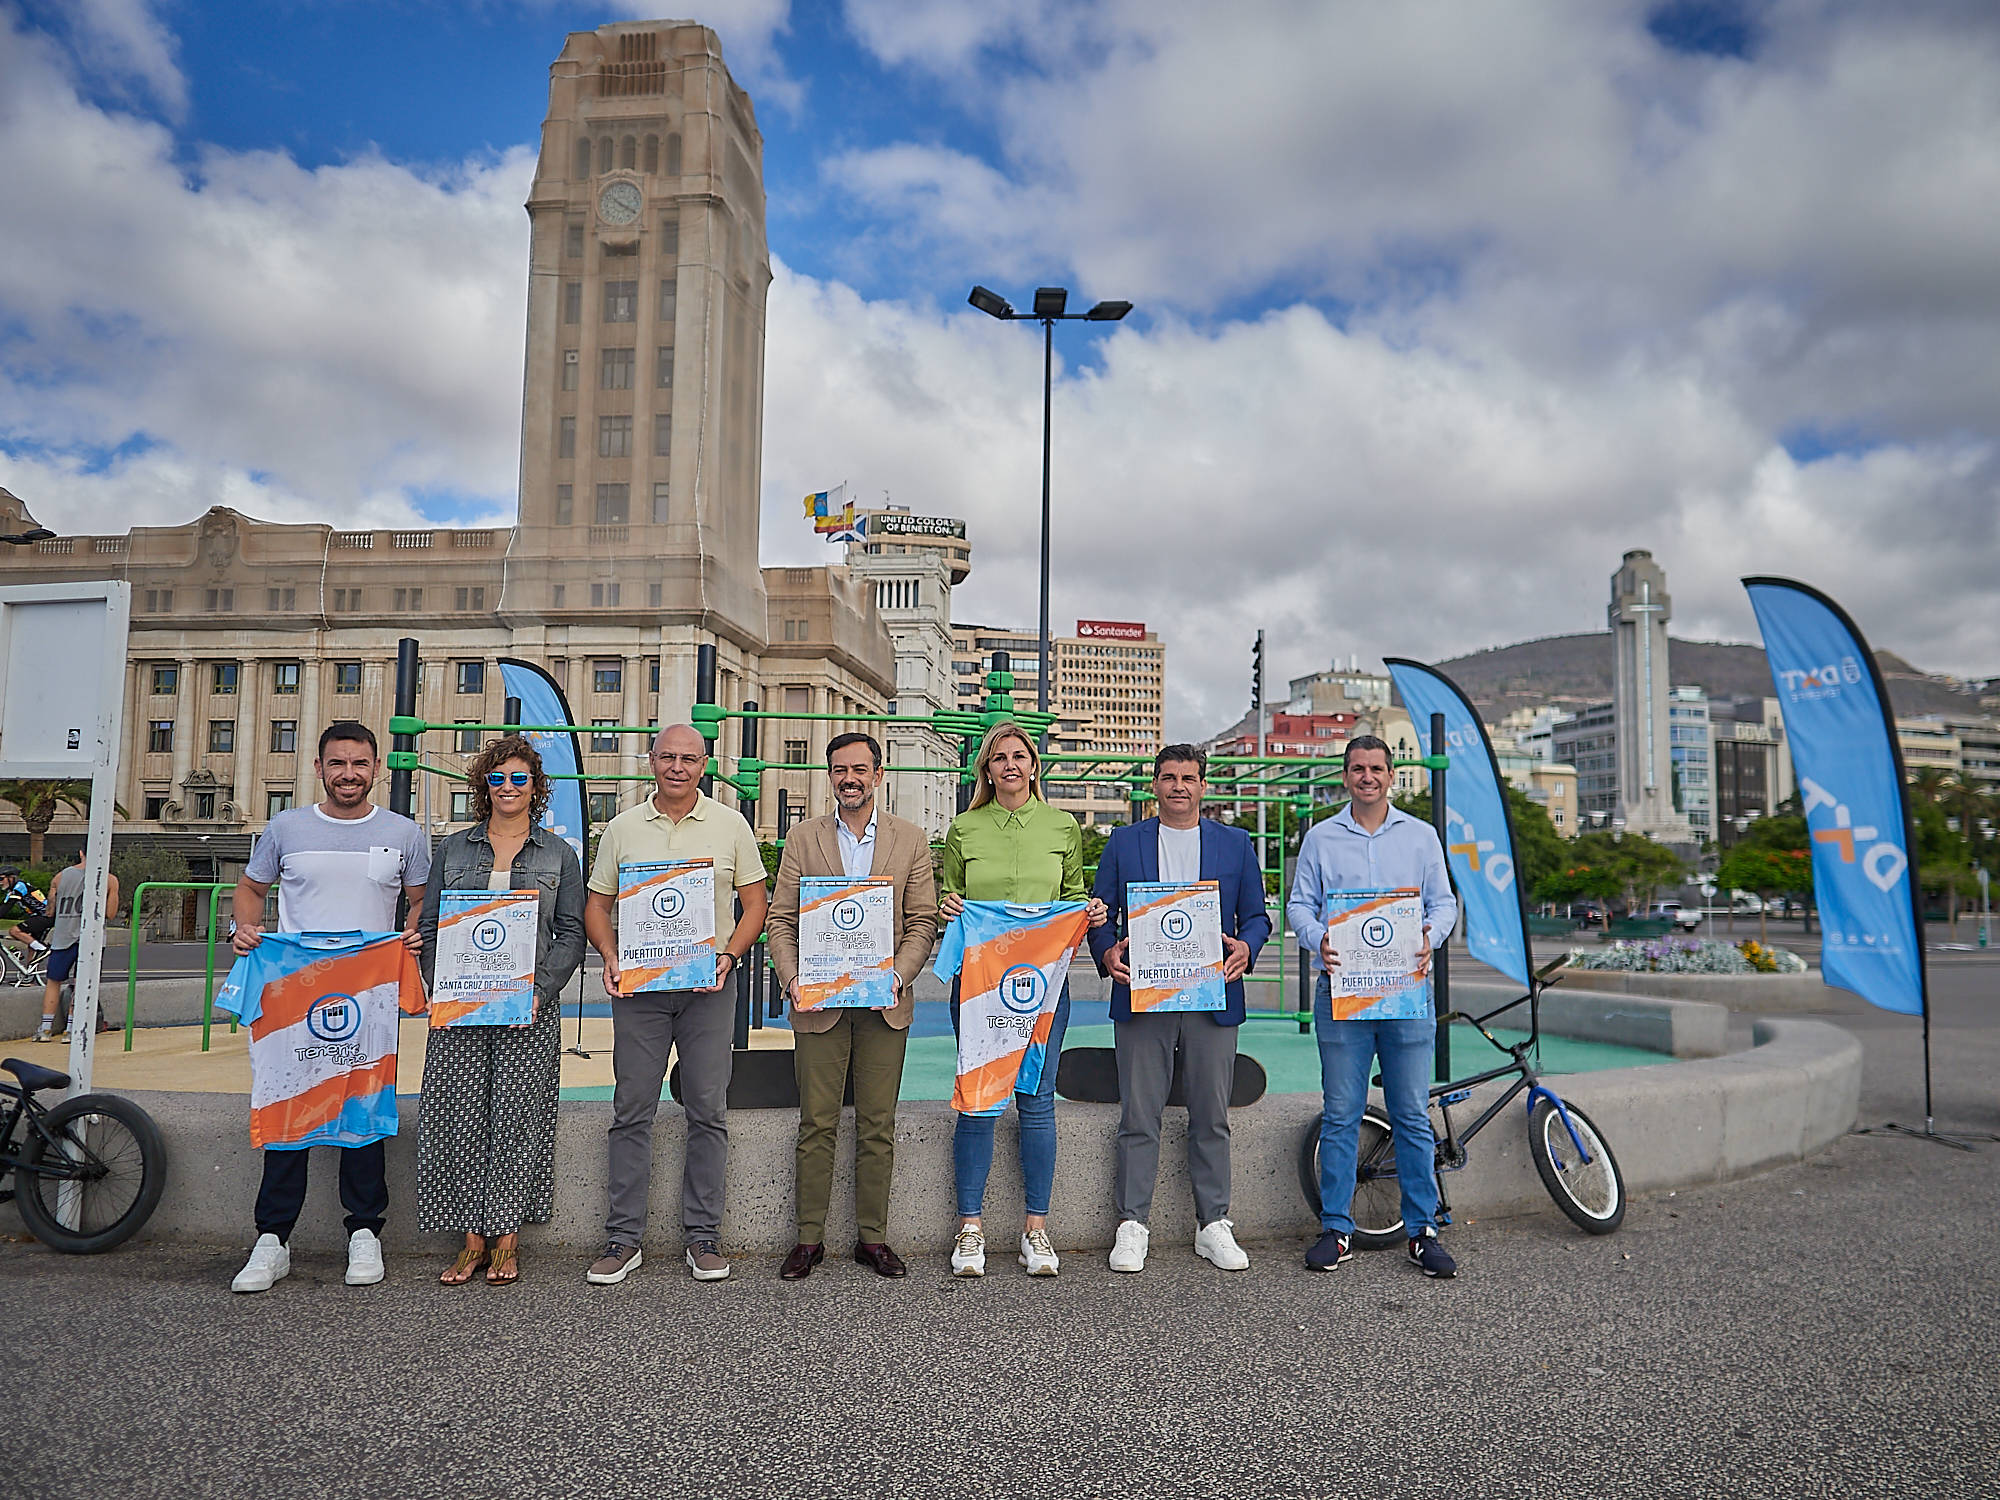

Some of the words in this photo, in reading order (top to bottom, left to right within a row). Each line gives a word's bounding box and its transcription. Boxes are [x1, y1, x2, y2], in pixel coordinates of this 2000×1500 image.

[881, 516, 914, 524] UNITED
[916, 518, 954, 527] COLORS
[886, 523, 898, 531] OF
[1093, 625, 1143, 638] Santander
[1735, 722, 1772, 742] BBVA
[689, 877, 708, 885] DXT
[1196, 900, 1214, 908] DXT
[512, 910, 532, 919] DXT
[637, 919, 692, 932] Tenerife
[663, 927, 696, 937] urbano
[817, 932, 870, 942] Tenerife
[842, 941, 876, 950] urbano
[1148, 942, 1199, 952] Tenerife
[623, 947, 663, 960] PUERTITO
[665, 946, 675, 957] DE
[1350, 950, 1400, 960] Tenerife
[456, 953, 511, 964] Tenerife
[481, 962, 516, 971] urbano
[1138, 968, 1169, 979] PUERTO
[1171, 968, 1181, 979] DE
[1183, 968, 1193, 979] LA
[1195, 967, 1216, 978] CRUZ
[438, 981, 462, 990] SANTA
[463, 981, 483, 990] CRUZ
[484, 981, 492, 989] DE
[495, 980, 529, 989] TENERIFE
[1342, 977, 1373, 987] PUERTO
[1375, 976, 1415, 987] SANTIAGO
